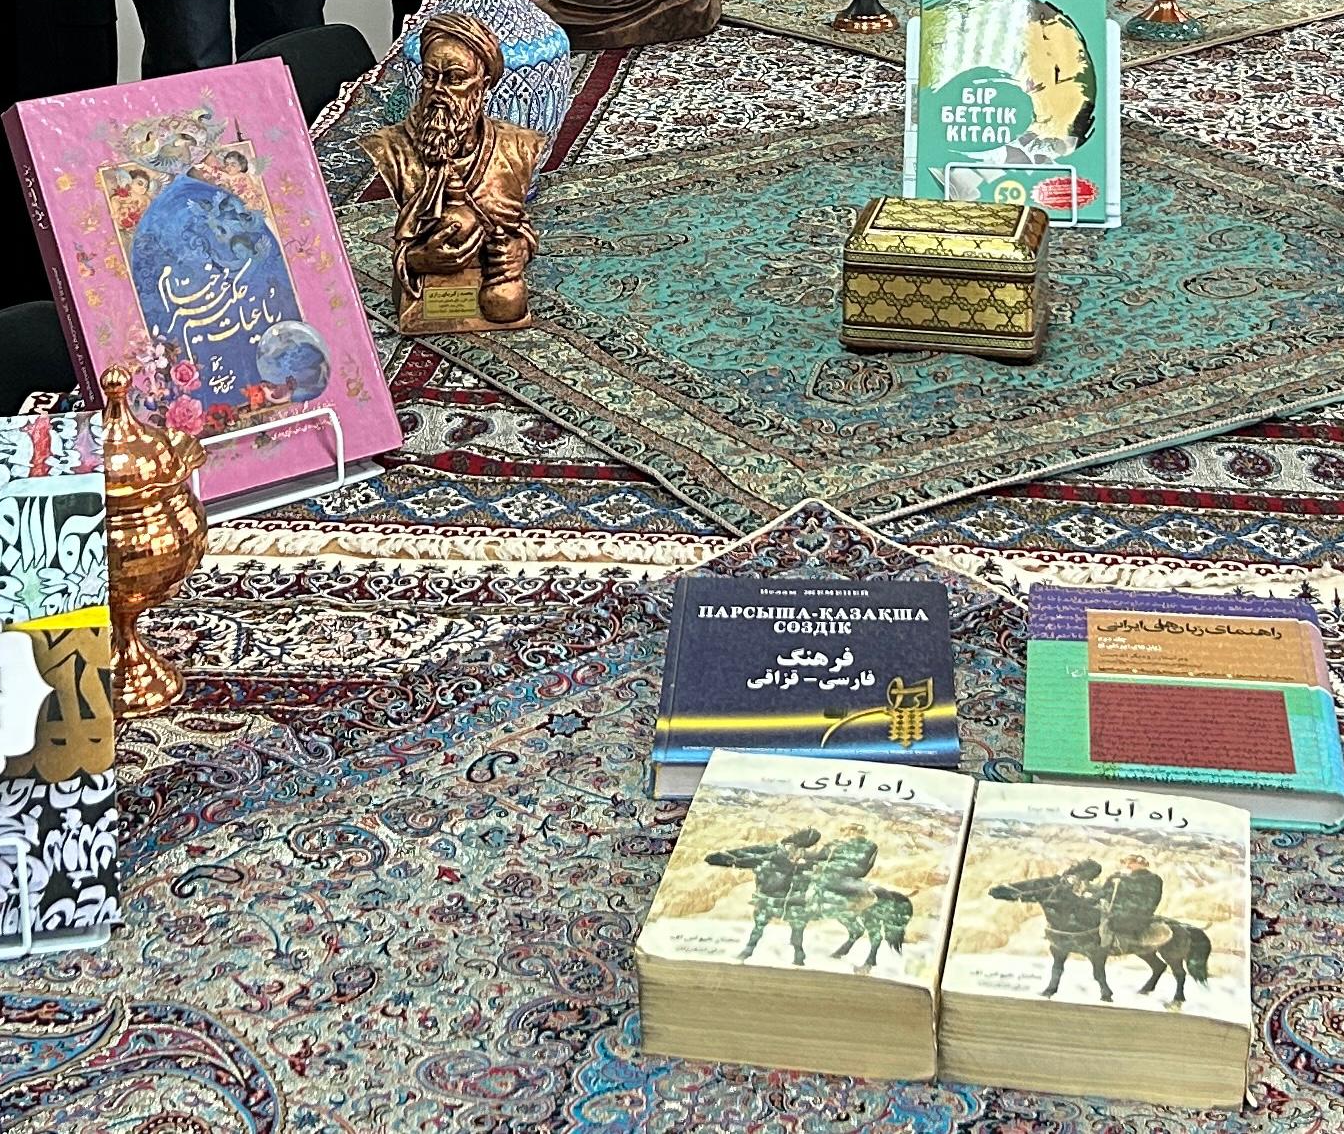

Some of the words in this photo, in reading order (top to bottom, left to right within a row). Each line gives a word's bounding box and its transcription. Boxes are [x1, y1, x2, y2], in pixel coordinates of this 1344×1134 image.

[962, 86, 998, 105] БІР
[941, 106, 1017, 124] БЕТТІК
[946, 125, 1011, 144] КІТАП
[773, 619, 853, 637] СӨЗДІК
[776, 646, 855, 673] فرهنگ
[746, 668, 800, 691] قزاقی
[818, 669, 877, 691] فارسی
[799, 770, 871, 792] آبای
[877, 779, 916, 800] راه
[1069, 797, 1139, 822] آبای
[1148, 807, 1188, 829] راه
